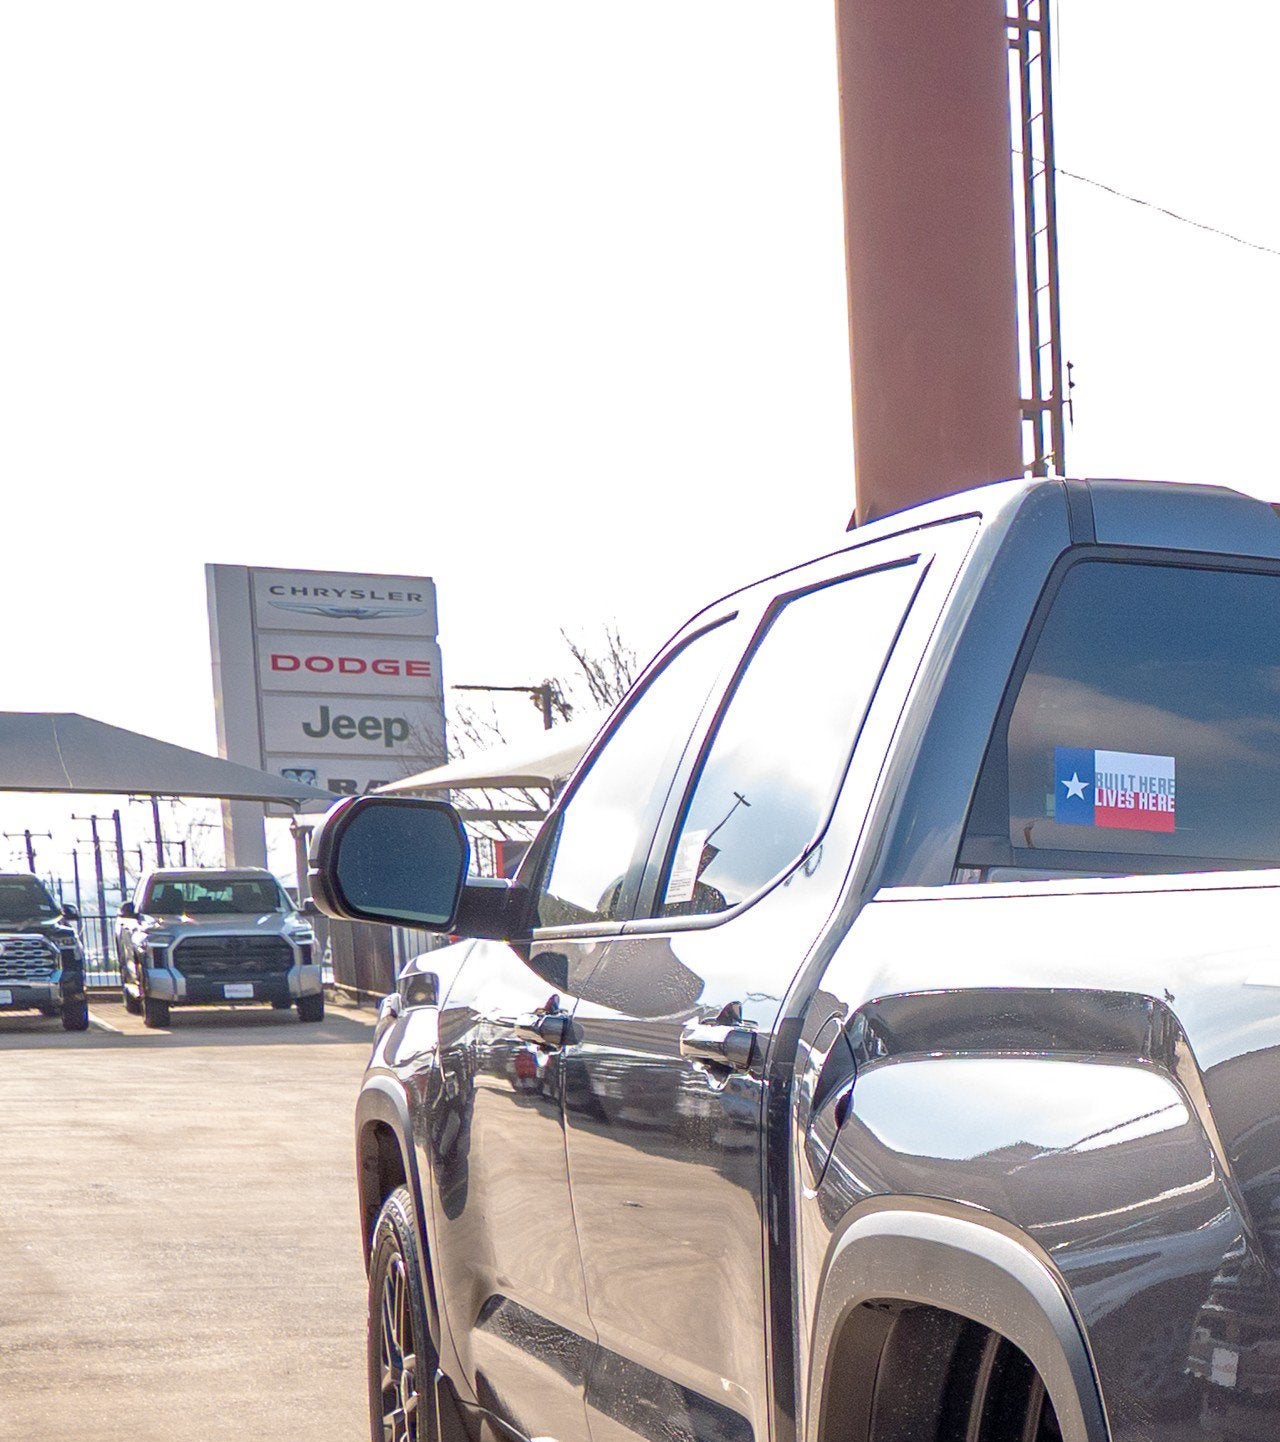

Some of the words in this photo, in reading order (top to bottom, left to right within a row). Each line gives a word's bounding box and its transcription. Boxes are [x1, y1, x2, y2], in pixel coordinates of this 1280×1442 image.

[269, 585, 424, 602] CHRYSLER
[270, 654, 432, 677] DODGE
[302, 705, 410, 748] Jeep
[1095, 772, 1136, 792] BUILT
[1139, 776, 1175, 795] HERE
[1095, 788, 1135, 809] LIVES
[1139, 792, 1175, 812] HERE
